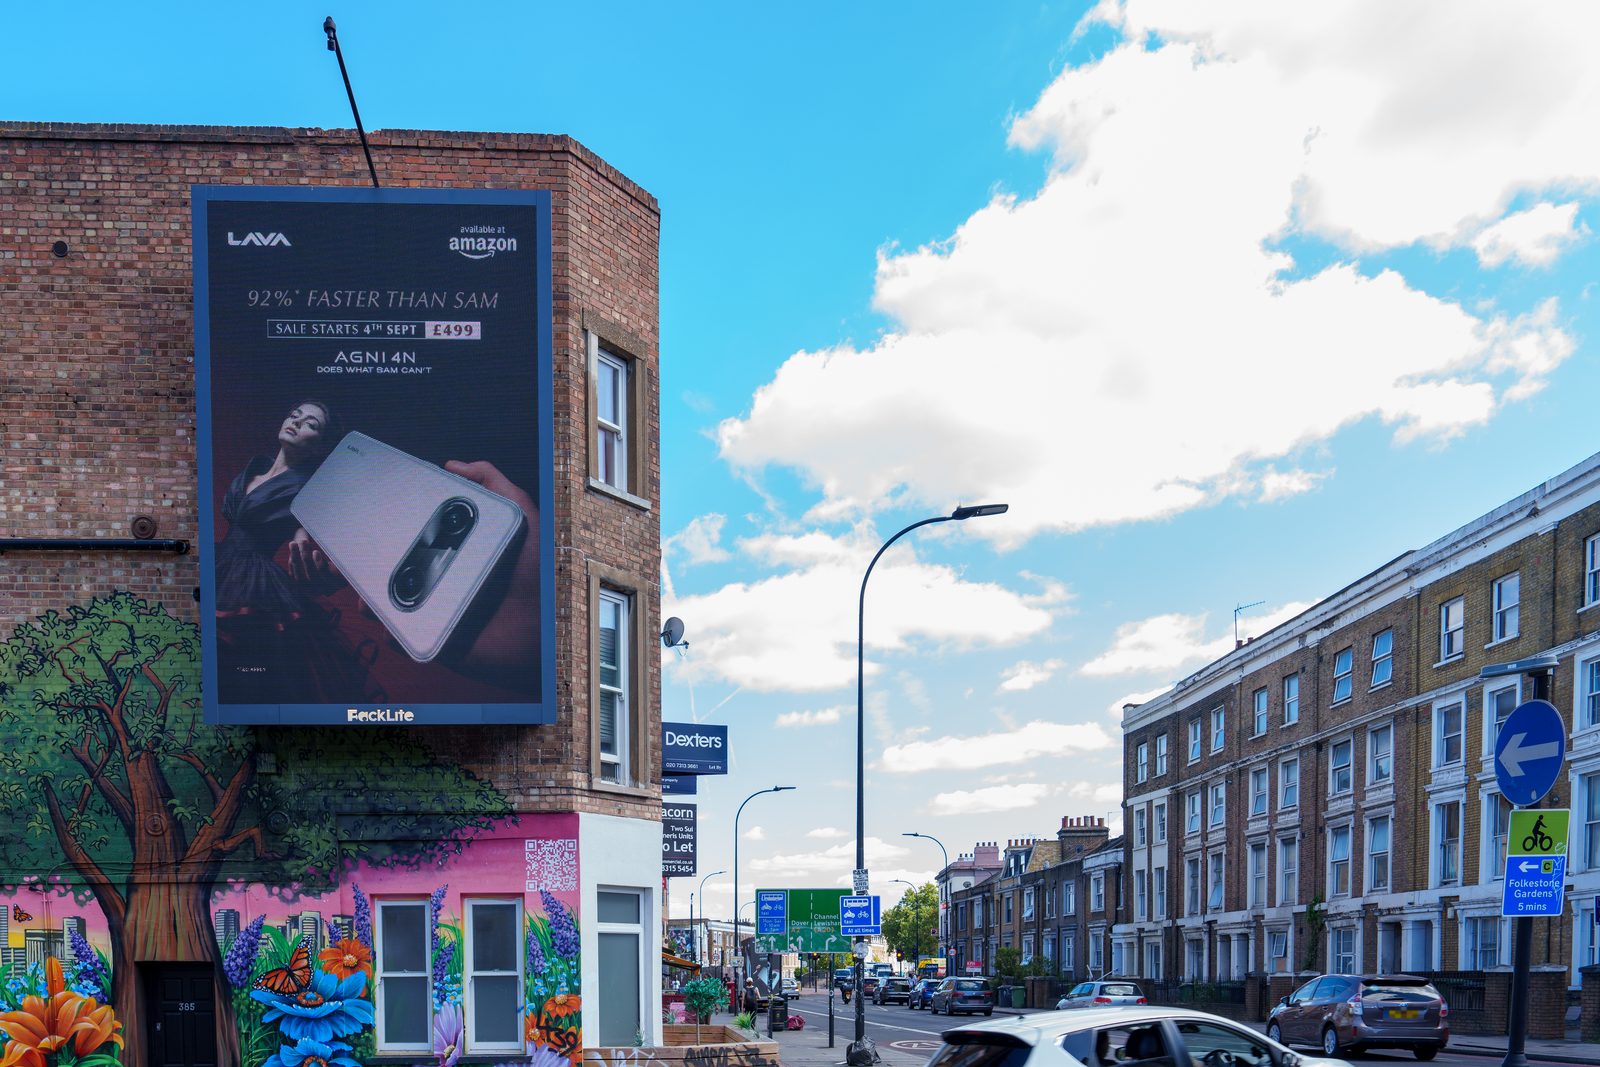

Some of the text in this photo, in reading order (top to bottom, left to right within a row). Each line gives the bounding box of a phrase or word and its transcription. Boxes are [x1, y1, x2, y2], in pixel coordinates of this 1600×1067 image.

[460, 225, 506, 234] available at
[228, 232, 292, 246] LAVA
[449, 237, 517, 251] amazon
[308, 290, 380, 308] FASTER
[386, 291, 447, 308] THAN
[453, 292, 499, 309] SAM
[276, 323, 473, 336] SALE STARTS 4TH SEPT £499
[334, 351, 416, 363] AGNI 4N
[377, 366, 398, 374] SAM
[401, 366, 432, 374] CAN'T
[665, 731, 722, 749] Dexters
[662, 808, 693, 818] acorn
[678, 832, 693, 840] Units
[662, 841, 693, 853] o Let
[677, 865, 693, 873] 5454
[1543, 862, 1551, 871] C
[1509, 879, 1560, 887] Folkestone
[1514, 889, 1553, 897] Gardens
[1518, 902, 1547, 911] 5 mins
[178, 1002, 195, 1011] 385
